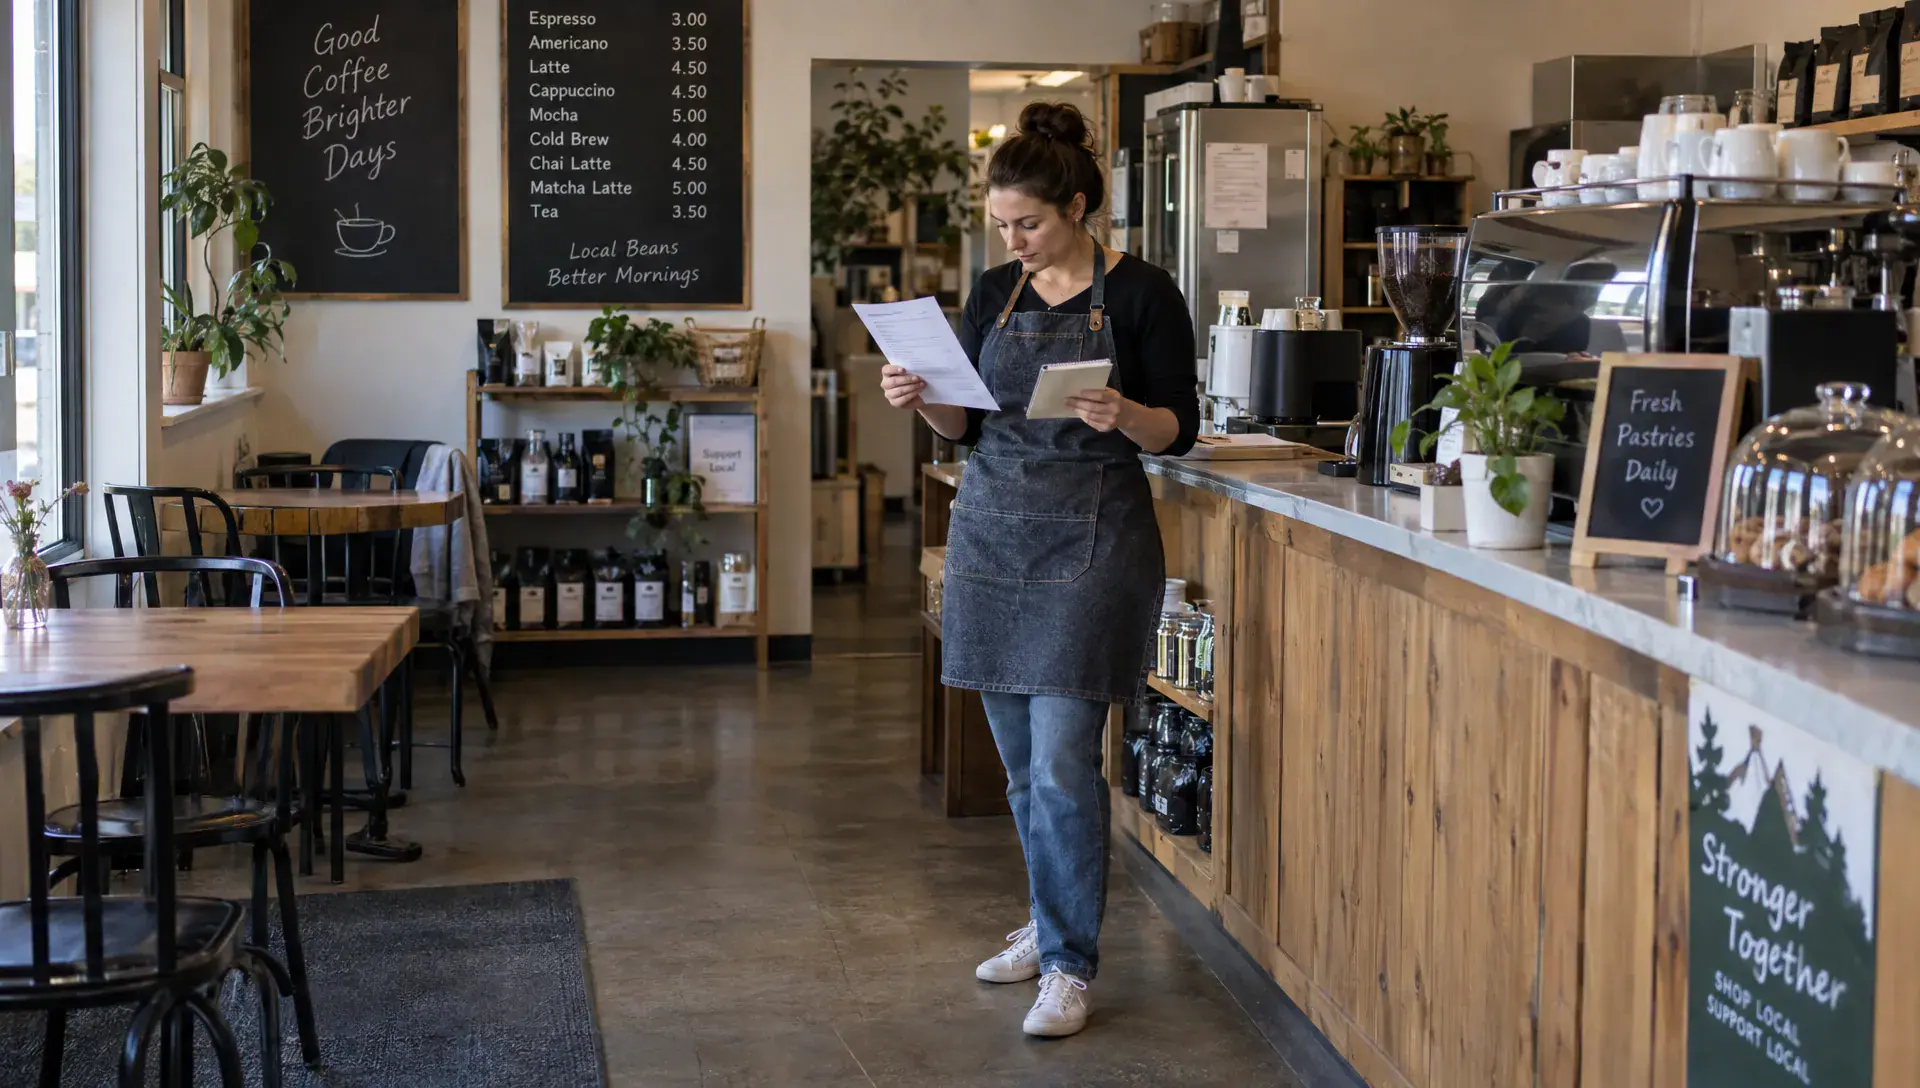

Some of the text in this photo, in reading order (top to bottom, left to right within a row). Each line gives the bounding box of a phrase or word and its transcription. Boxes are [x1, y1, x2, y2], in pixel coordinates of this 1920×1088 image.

[529, 10, 707, 29] Espresso 3.00
[314, 14, 380, 56] Good
[529, 35, 707, 51] Americano 3.50
[303, 56, 390, 99] Coffee
[529, 59, 707, 75] Latte 4.50
[529, 83, 707, 101] Cappuccino 4.50
[302, 93, 412, 140] Brighter
[529, 107, 707, 123] Mocha 5.00
[529, 131, 707, 147] Cold Brew 4.00
[323, 140, 397, 182] Days
[529, 155, 707, 171] Chai Latte 4.50
[530, 180, 707, 195] Matcha Latte 5.00
[530, 204, 707, 219] Tea 3.50
[569, 239, 679, 260] Local Beans
[547, 266, 700, 288] Better Mornings
[1630, 389, 1683, 413] Fresh
[1617, 423, 1695, 448] Pastries
[702, 448, 742, 459] Support
[709, 462, 736, 473] Local
[1625, 458, 1679, 491] Daily
[1701, 832, 1814, 932] Stronger
[1723, 905, 1846, 1010] Together
[1714, 969, 1801, 1046] SHOP LOCAL
[1705, 994, 1811, 1085] SUPPORT LOCAL
